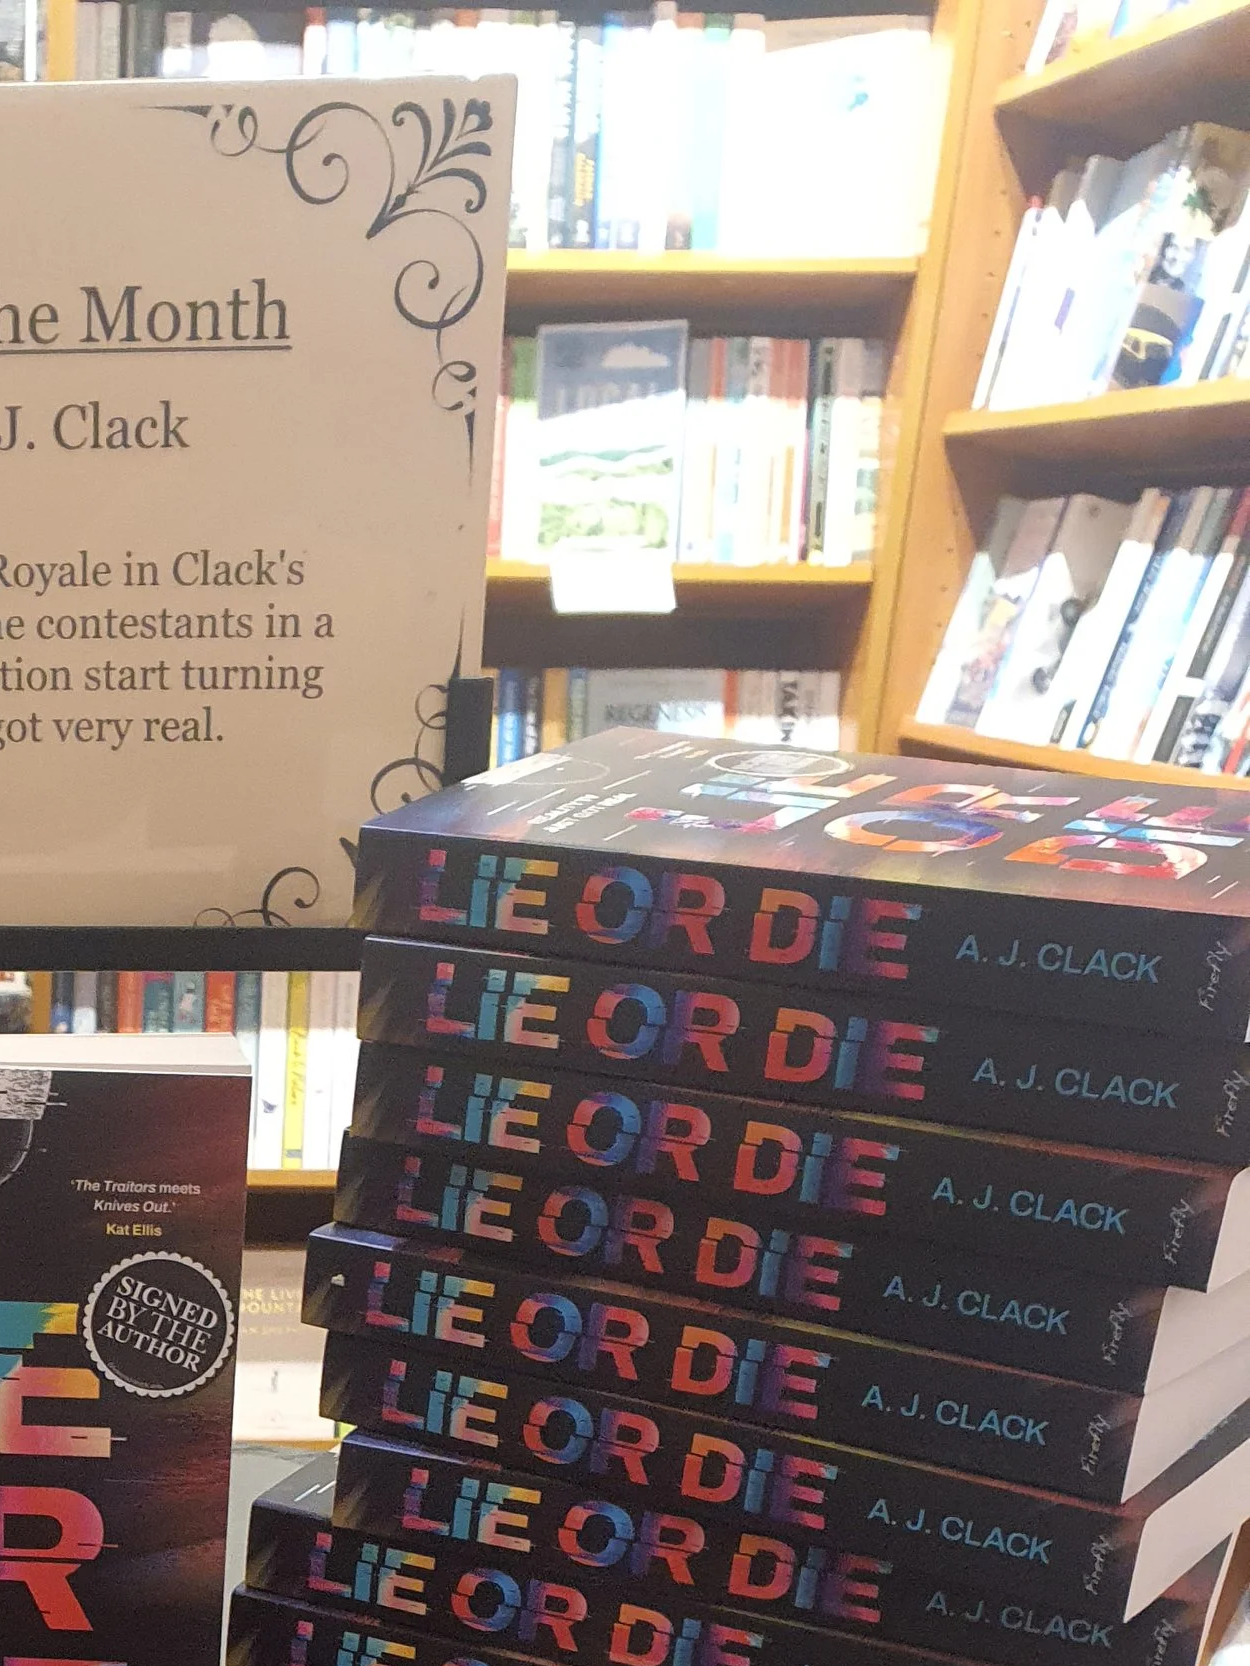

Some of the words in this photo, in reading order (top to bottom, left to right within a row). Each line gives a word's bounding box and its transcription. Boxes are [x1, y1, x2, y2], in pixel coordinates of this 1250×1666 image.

[79, 278, 290, 343] Month
[53, 400, 190, 450] Clack
[124, 551, 159, 586] in
[173, 549, 306, 586] Clack's
[36, 607, 253, 640] contestants
[265, 603, 302, 638] in
[314, 612, 335, 638] a
[84, 659, 170, 692] start
[181, 655, 324, 699] turning
[53, 718, 133, 751] very
[143, 707, 224, 742] real.
[576, 866, 727, 956] OR
[955, 935, 988, 963] A.
[998, 939, 1026, 968] J.
[1037, 942, 1164, 984] CLACK
[94, 1200, 140, 1213] Knives
[104, 1180, 157, 1194] Traitors
[159, 1183, 201, 1195] meets
[106, 1223, 129, 1236] Kat
[133, 1224, 162, 1237] Ellis
[538, 1186, 674, 1274] OR
[882, 1275, 913, 1301] A.
[923, 1284, 948, 1310] J.
[958, 1291, 1071, 1335] CLACK
[106, 1296, 147, 1328] BY
[150, 1311, 212, 1355] THE
[116, 1275, 219, 1330] SIGNED
[97, 1320, 201, 1373] AUTHOR
[451, 1568, 588, 1652] OR
